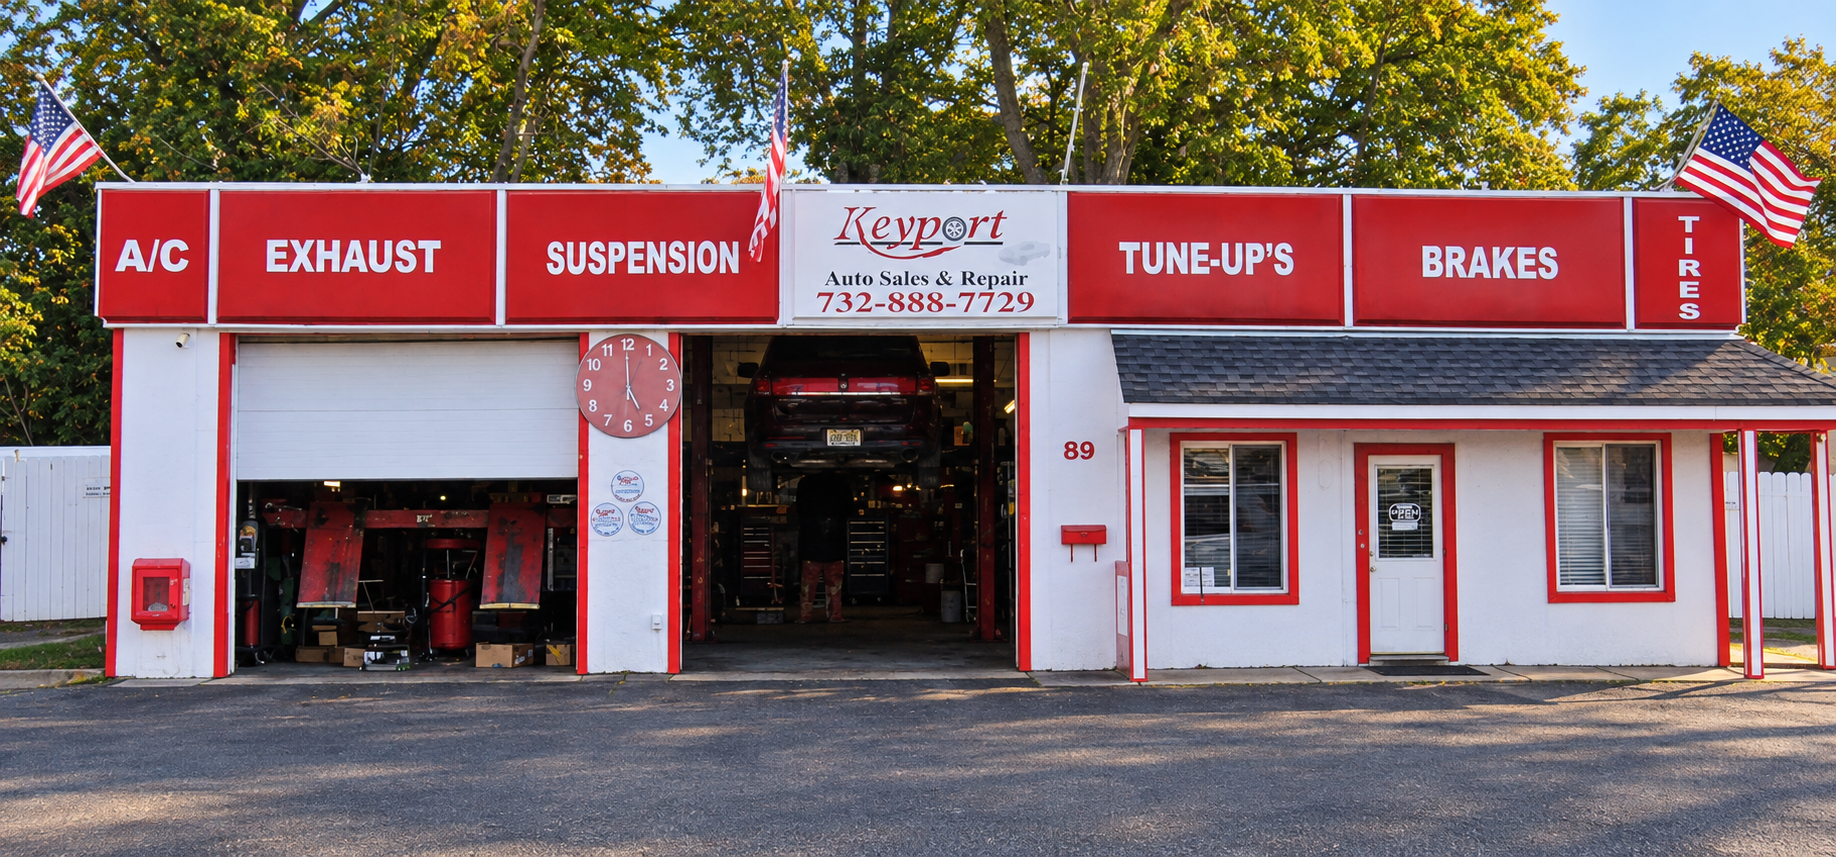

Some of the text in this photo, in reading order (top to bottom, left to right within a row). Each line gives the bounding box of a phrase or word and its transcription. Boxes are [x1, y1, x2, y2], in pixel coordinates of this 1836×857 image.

[833, 207, 1007, 259] Keyport
[115, 238, 190, 273] A/C
[266, 239, 442, 274] EXHAUST
[546, 240, 740, 276] SUSPENSION
[1119, 241, 1295, 276] TUNE-UP’S
[1421, 245, 1559, 280] BRAKES
[1677, 215, 1701, 320] TIRES
[825, 271, 1028, 289] Auto Sales & Repair
[817, 291, 1035, 313] 732-888-7729
[601, 343, 613, 357] 11
[621, 338, 635, 351] 12
[646, 343, 652, 357] 1
[587, 358, 601, 371] 10
[659, 358, 668, 371] 2
[583, 378, 592, 392] 9
[666, 378, 675, 392] 3
[588, 399, 597, 412] 8
[659, 399, 668, 412] 4
[603, 414, 613, 427] 7
[623, 419, 633, 432] 6
[644, 414, 653, 427] 5
[1063, 440, 1095, 461] 89
